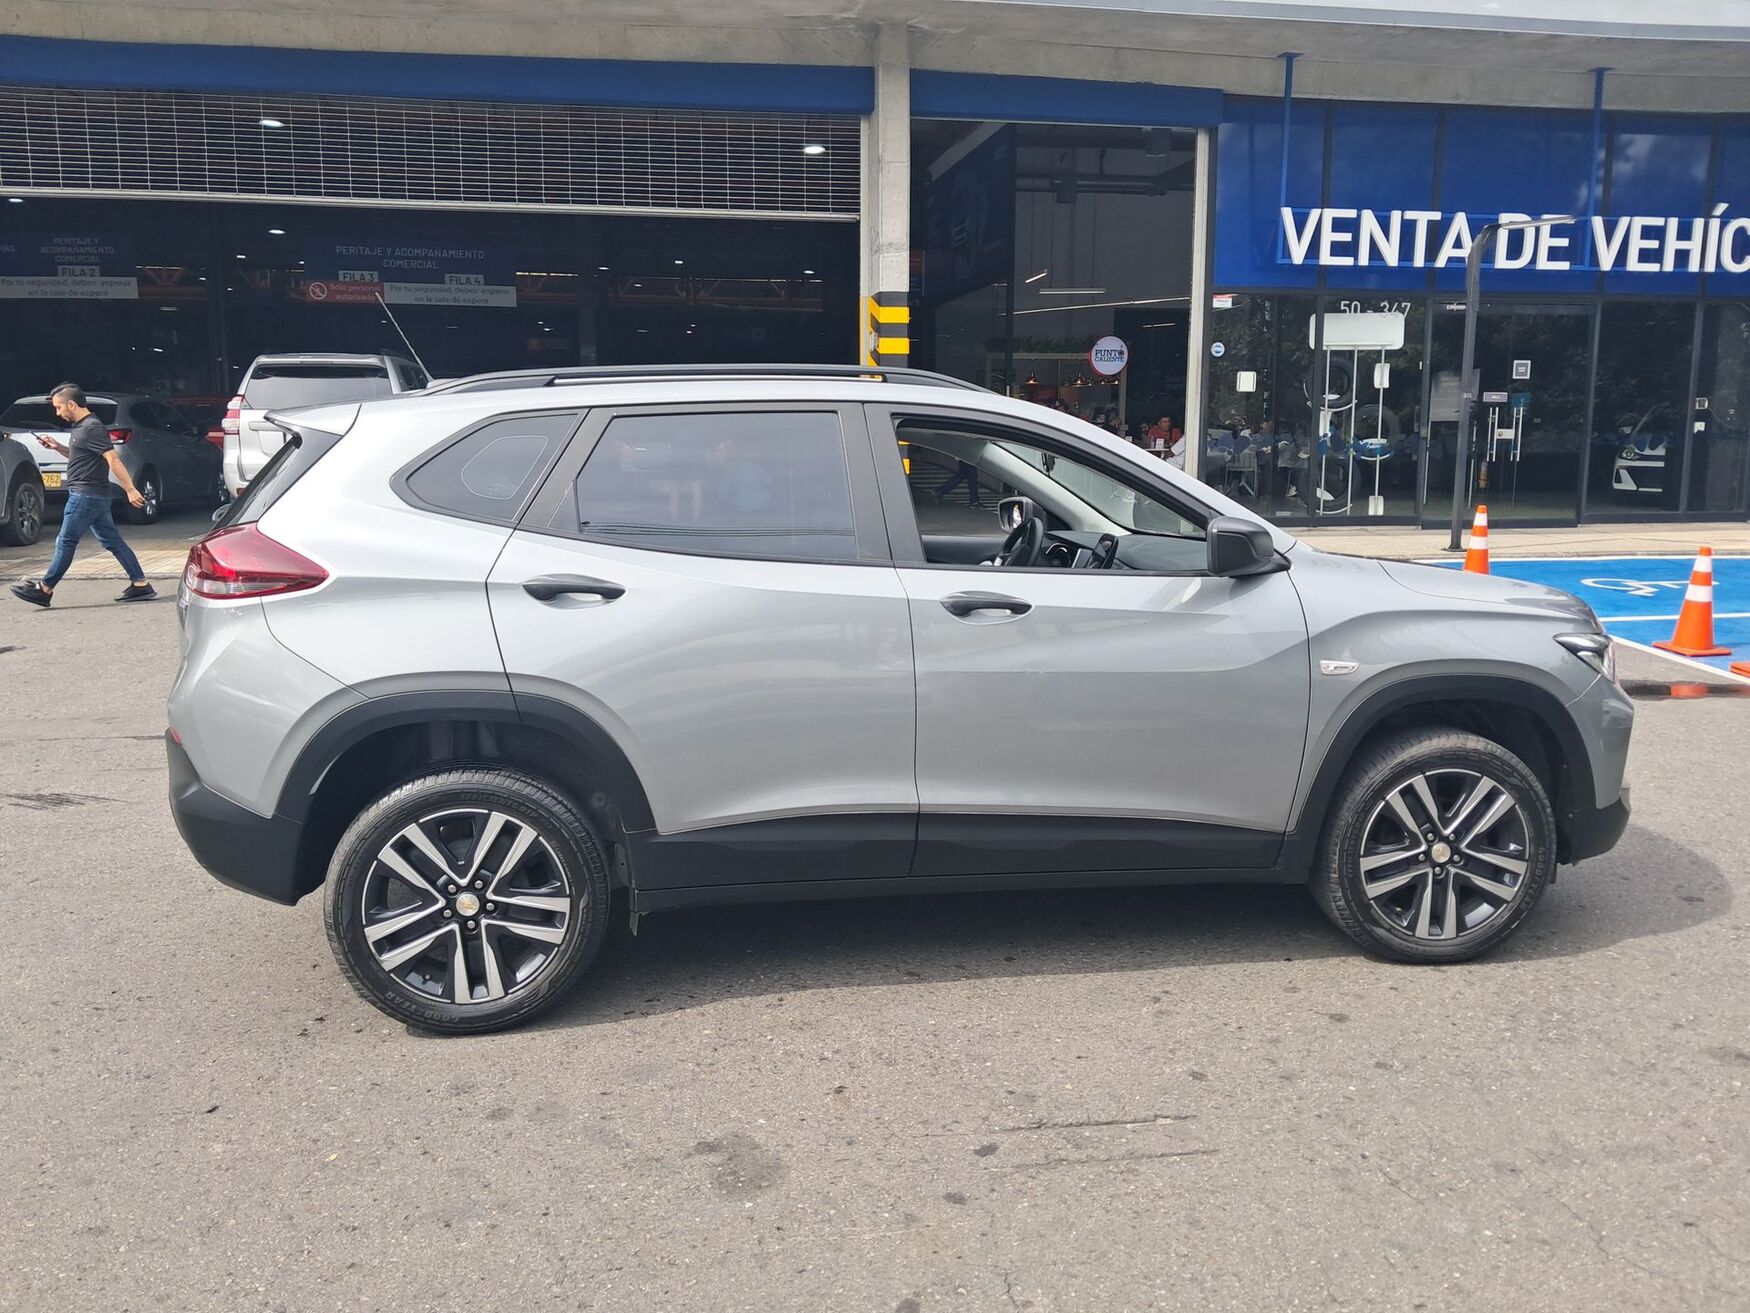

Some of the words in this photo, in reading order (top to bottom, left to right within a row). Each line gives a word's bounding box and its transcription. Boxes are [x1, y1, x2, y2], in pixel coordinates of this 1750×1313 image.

[1280, 206, 1473, 268] VENTA
[1494, 212, 1571, 270] DE
[1591, 202, 1750, 273] VEHÍC
[336, 245, 384, 256] PERITAJE
[385, 247, 392, 256] Y
[394, 247, 485, 260] ACOMPAÑAMIENTO
[383, 258, 440, 269] COMERCIAL
[62, 268, 86, 277] FILA
[88, 268, 97, 277] 2
[343, 272, 366, 281] FILA
[367, 272, 375, 281] 3
[449, 275, 474, 286] FILA
[474, 276, 481, 286] 4
[1341, 300, 1360, 313] 50
[1380, 301, 1411, 319] 347
[1095, 349, 1125, 357] PUNTO
